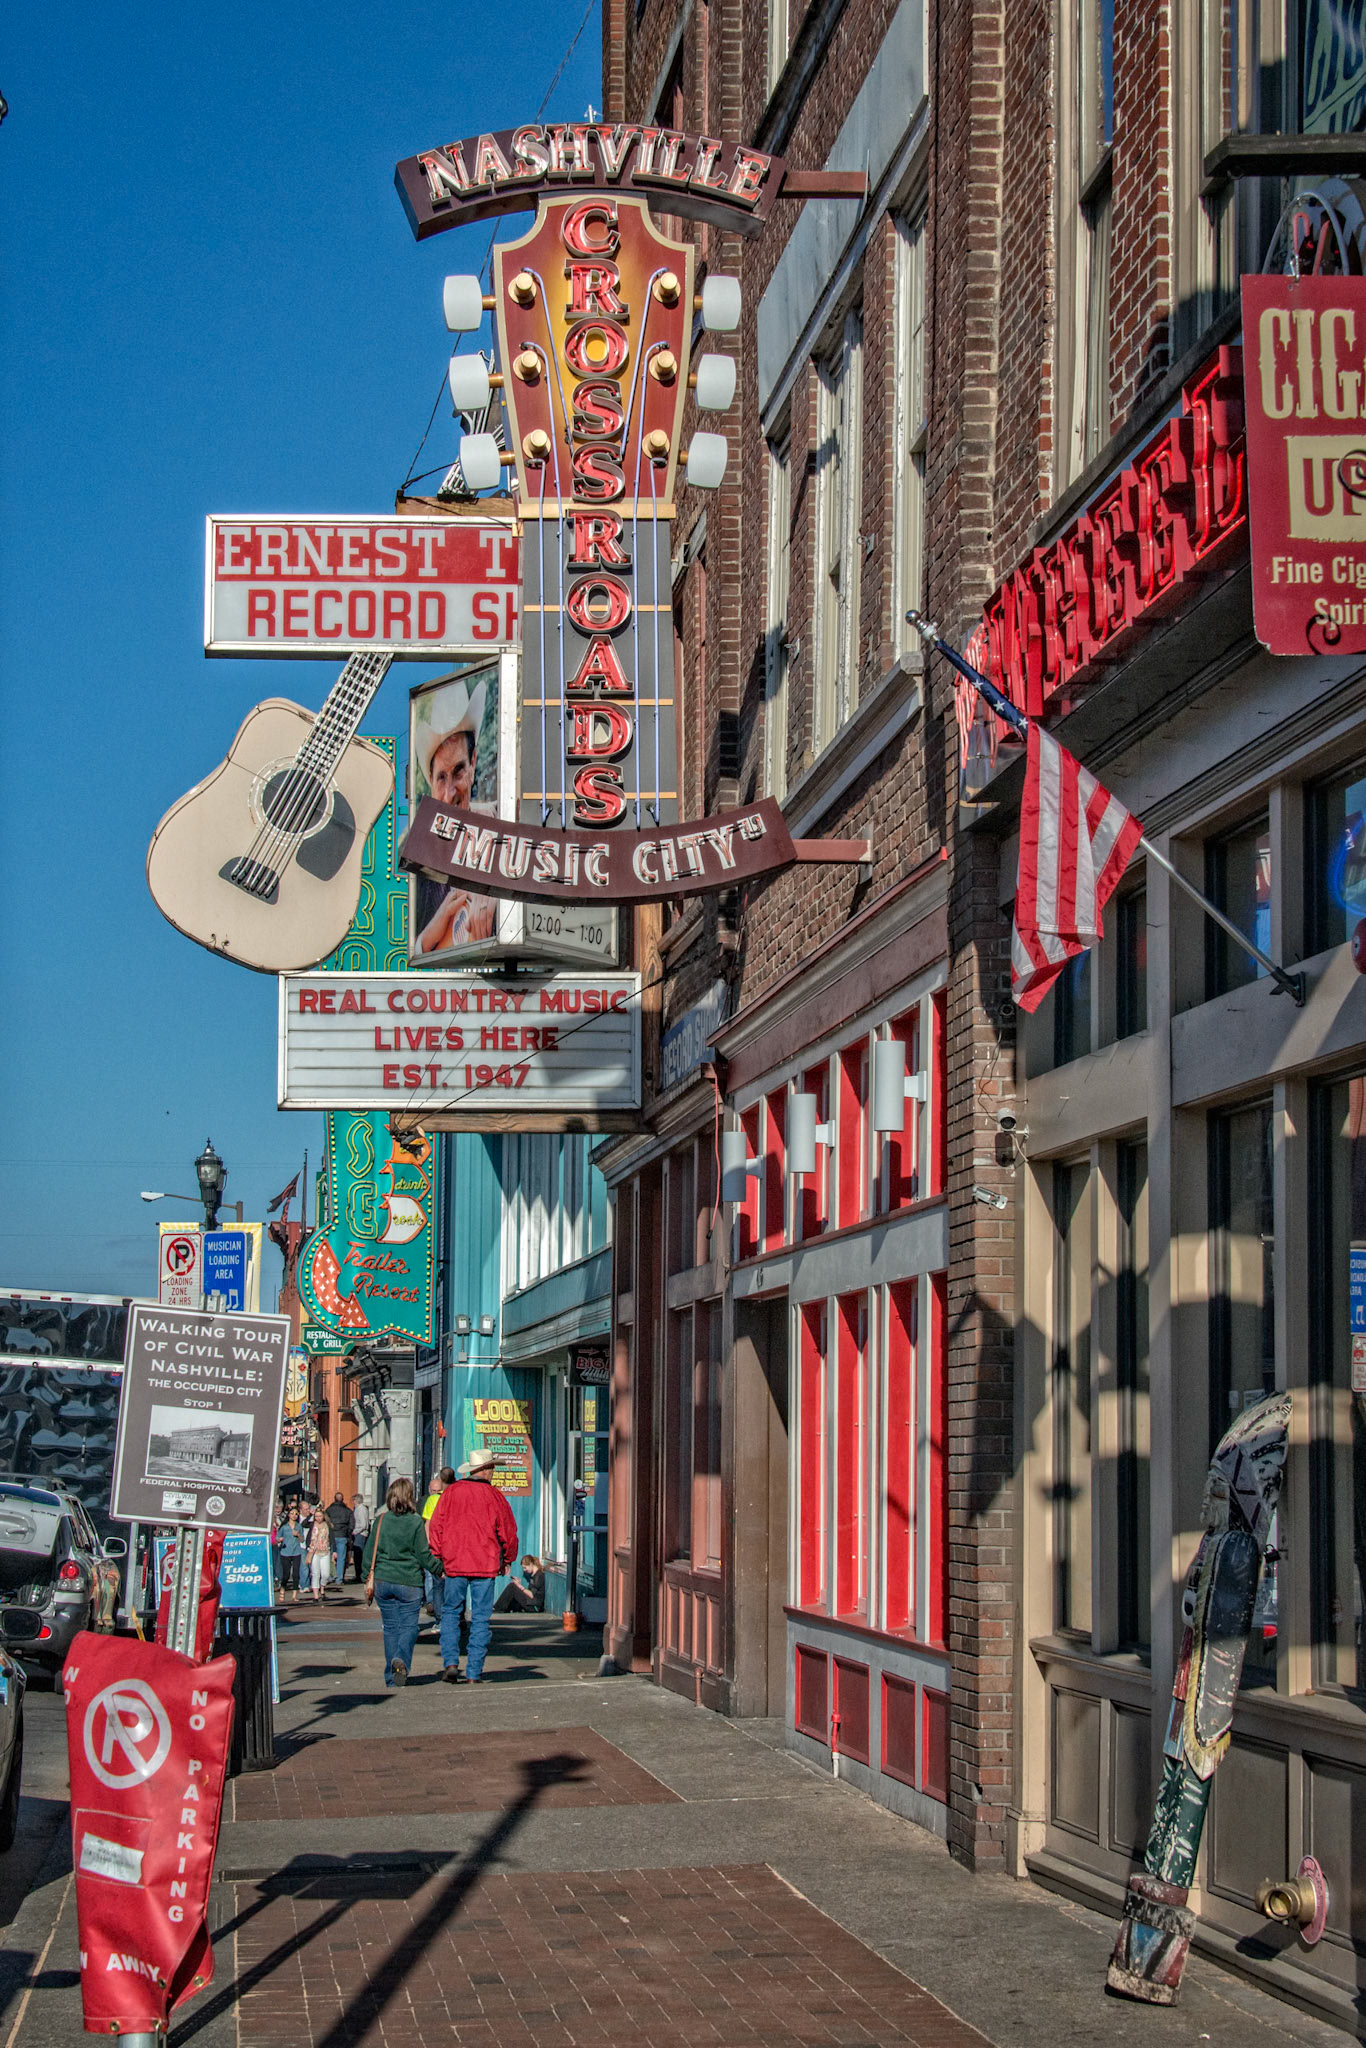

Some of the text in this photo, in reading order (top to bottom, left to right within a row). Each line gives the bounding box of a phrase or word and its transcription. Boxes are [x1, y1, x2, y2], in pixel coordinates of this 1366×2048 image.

[417, 123, 771, 209] NASHVILLE
[1259, 308, 1366, 419] CIG
[561, 198, 633, 827] CROSSROADS
[218, 527, 512, 577] ERNEST T
[1270, 556, 1323, 584] Fine
[248, 589, 446, 639] RECORD
[531, 913, 561, 935] 12:00
[580, 924, 603, 944] 1:00
[299, 988, 628, 1014] REAL COUNTRY MUSIC
[375, 1026, 559, 1051] LIVES HERE
[663, 1024, 692, 1089] RECORD
[382, 1064, 531, 1089] EST. 1947
[207, 1240, 241, 1252] MUSICIAN
[344, 1240, 410, 1275] Trailer
[208, 1255, 240, 1265] LOADING
[167, 1277, 193, 1286] LOADING
[215, 1269, 233, 1279] AREA
[171, 1288, 188, 1296] ZONE
[353, 1271, 419, 1303] Resort
[179, 1297, 192, 1305] HRS
[140, 1318, 282, 1345] WALKING TOUR
[144, 1340, 273, 1363] OF CIVIL WAR
[313, 1339, 343, 1348] & GRILL
[151, 1359, 263, 1382] NASHVILLE:
[148, 1378, 263, 1397] THE OCCUPIED CITY
[183, 1398, 223, 1409] STOP 1
[474, 1399, 529, 1422] LOOK
[476, 1424, 509, 1434] BEHIND
[487, 1436, 525, 1445] YOU JUST
[518, 1446, 528, 1454] IT
[140, 1478, 182, 1488] FEDERAL
[183, 1481, 227, 1492] HOSPITAL
[228, 1485, 245, 1494] NO.
[224, 1564, 259, 1574] Tubb
[225, 1574, 262, 1584] Shop
[189, 1690, 208, 1732] NO
[168, 1759, 203, 1923] PARKING
[106, 1952, 160, 1983] AWAY
